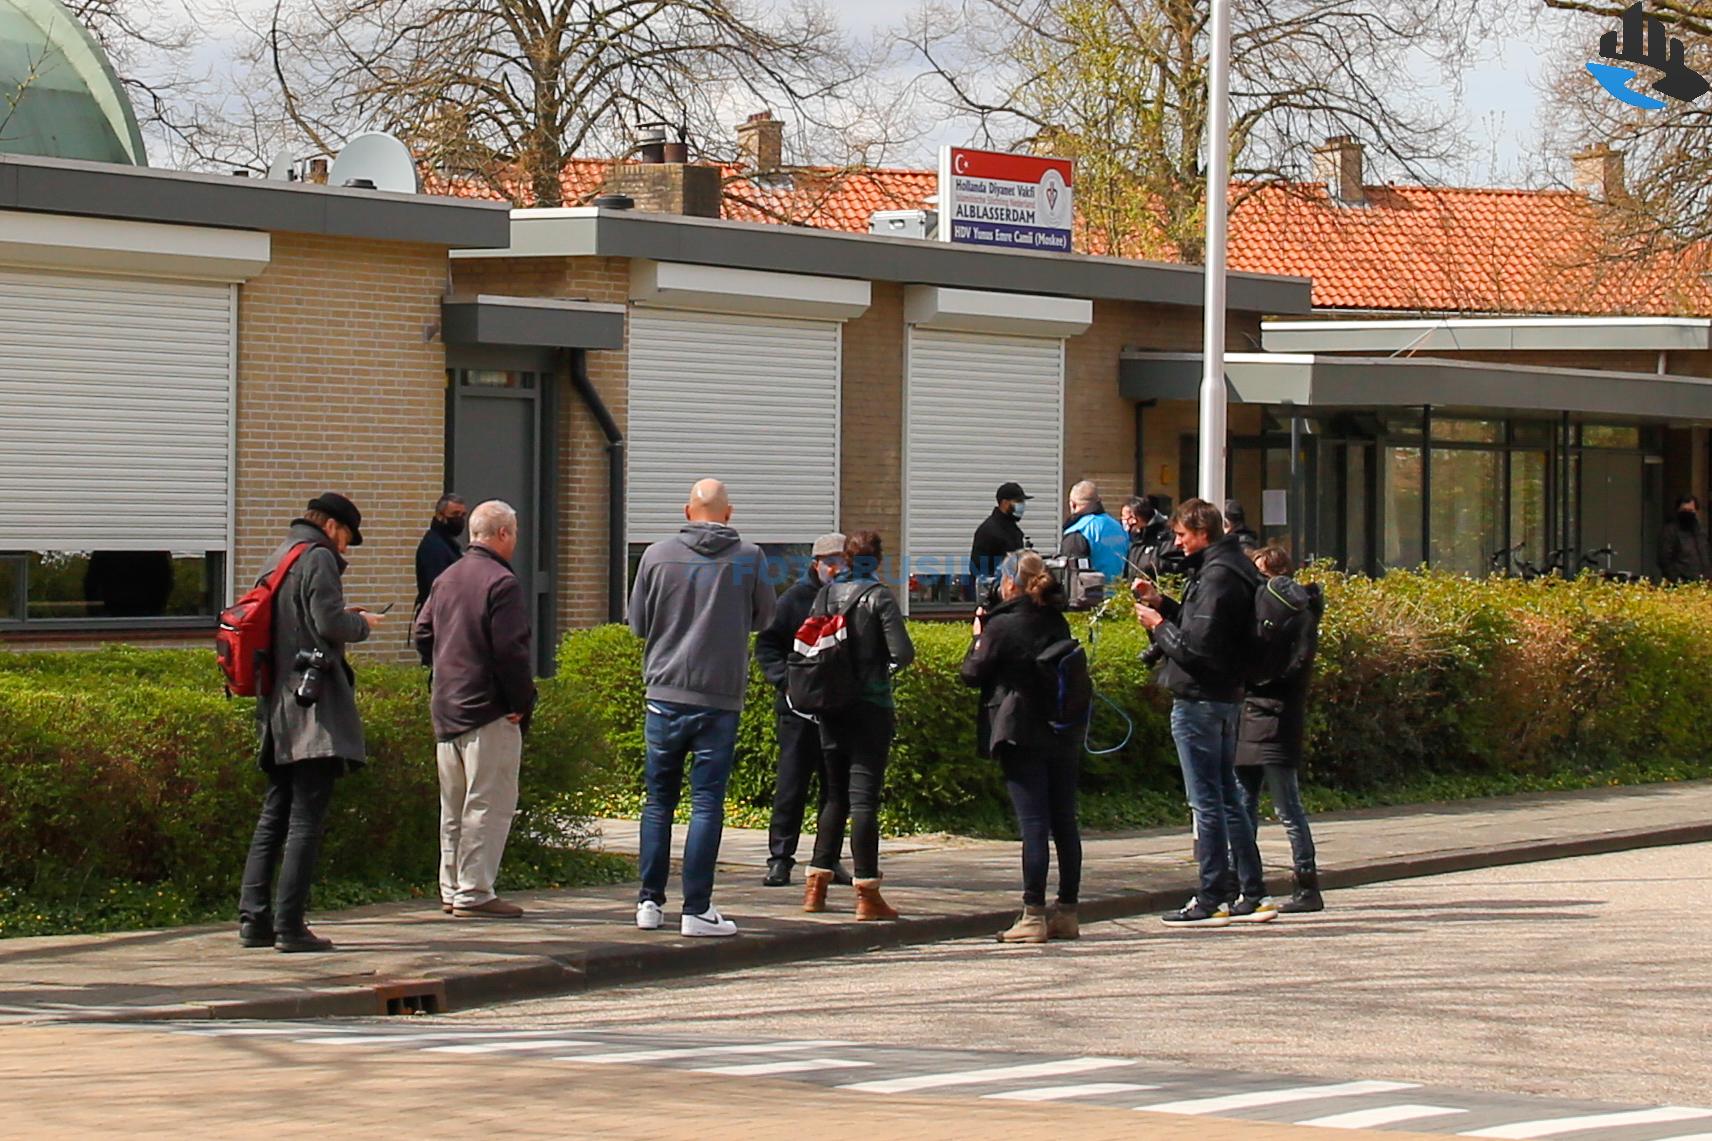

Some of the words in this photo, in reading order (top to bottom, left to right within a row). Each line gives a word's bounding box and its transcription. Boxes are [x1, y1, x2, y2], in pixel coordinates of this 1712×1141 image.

[956, 179, 986, 193] Hollanda
[989, 182, 1015, 197] Diyanet
[956, 204, 1035, 224] ALBLASSERDAM
[954, 225, 971, 238] HDV
